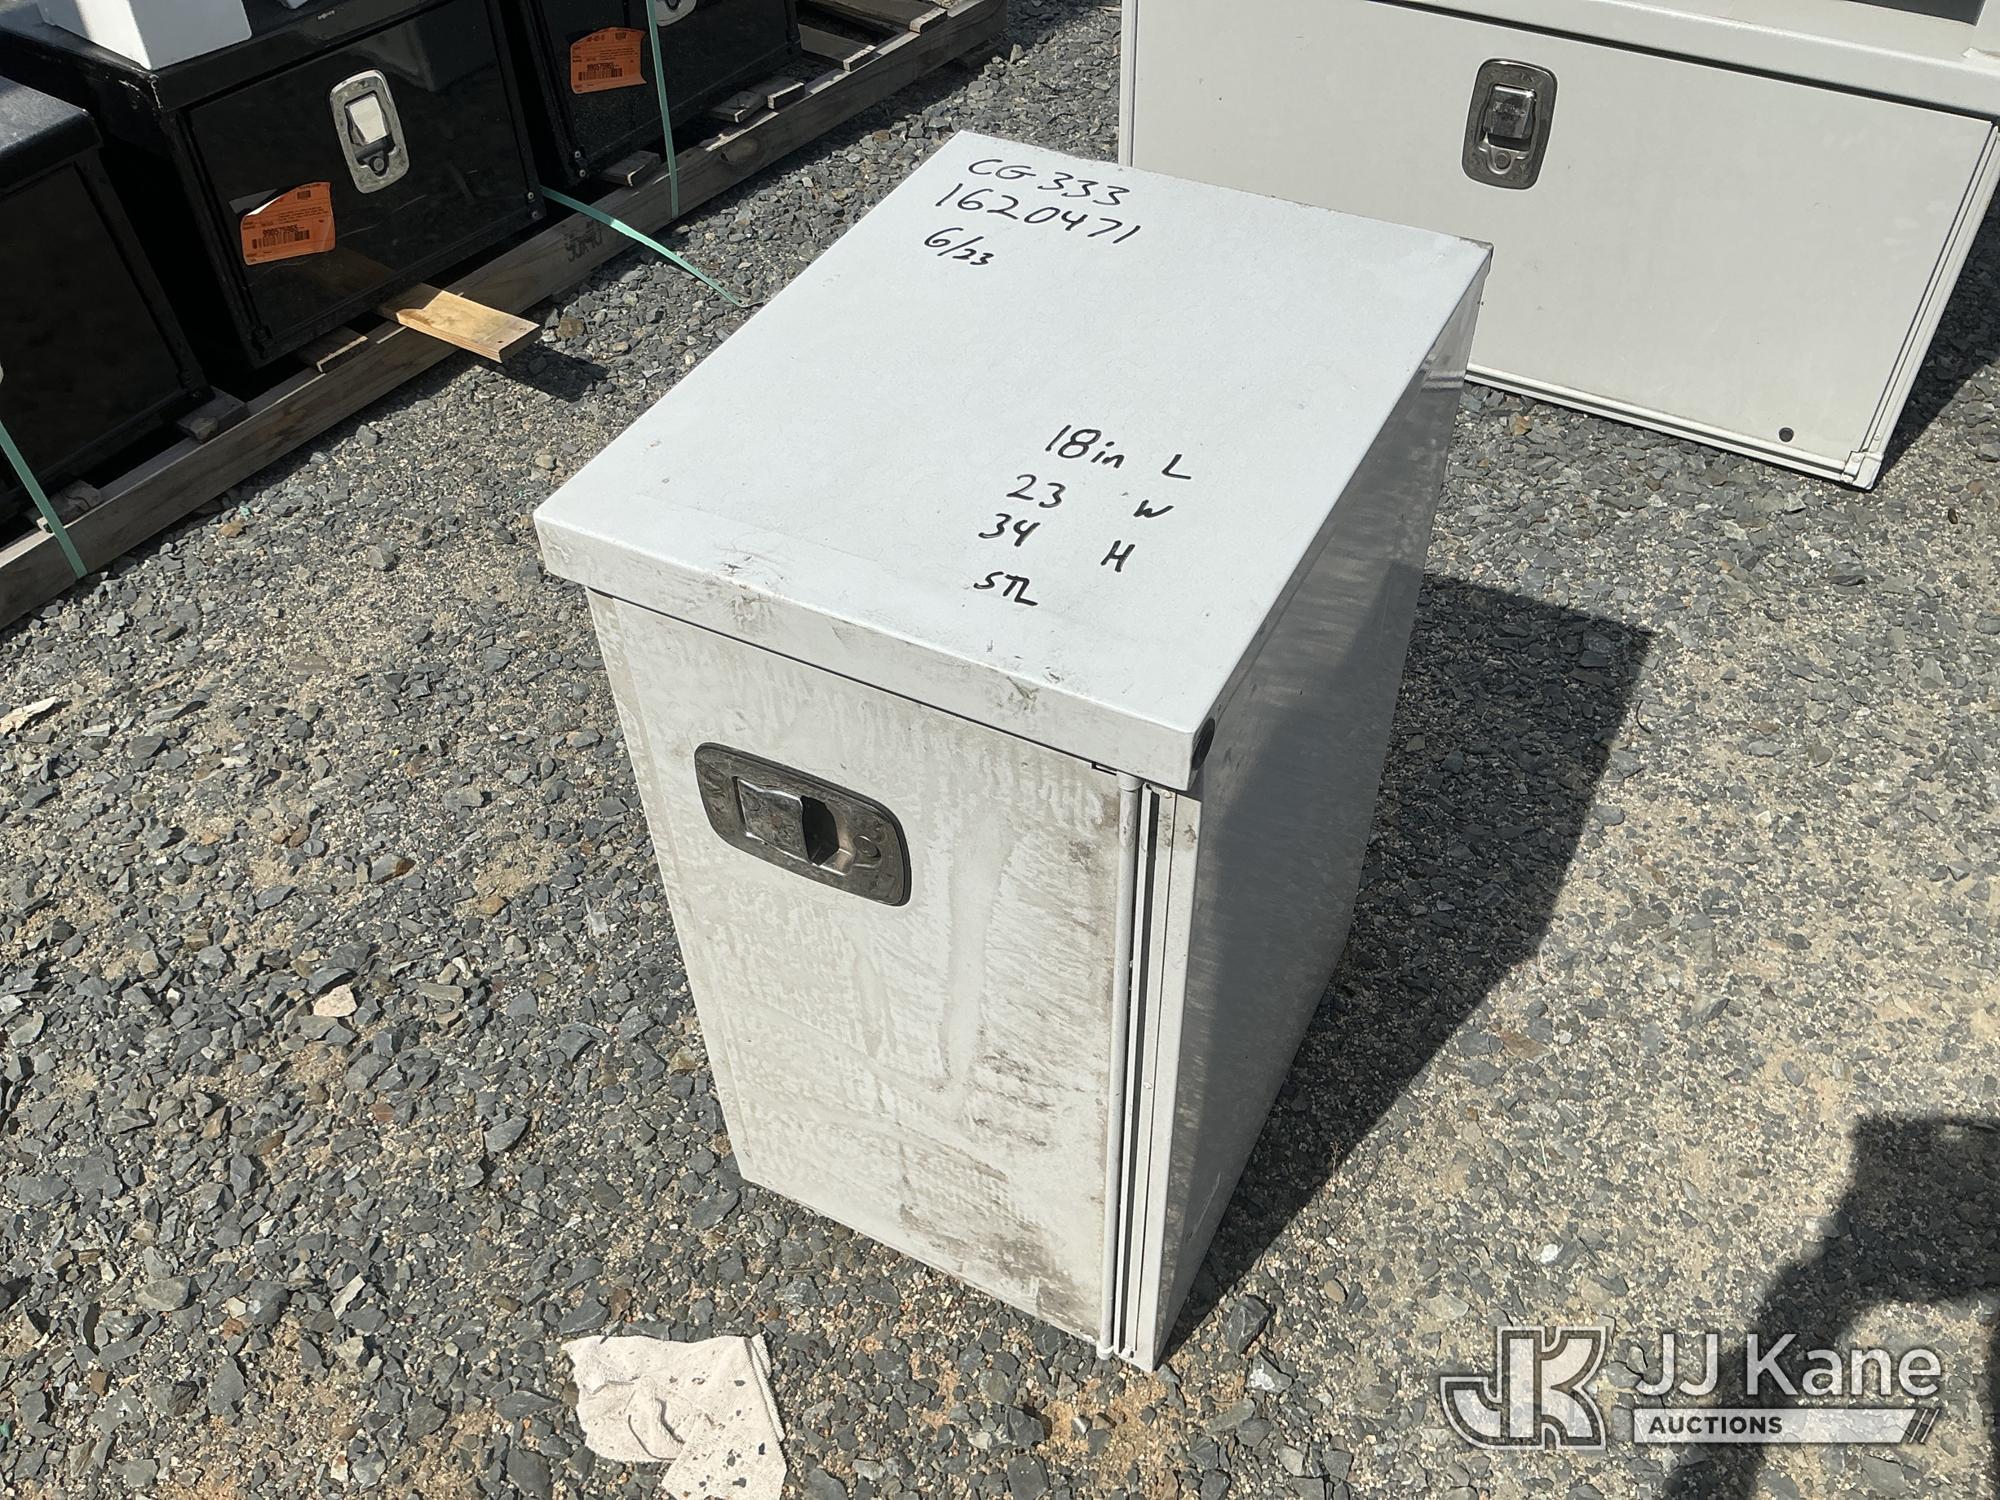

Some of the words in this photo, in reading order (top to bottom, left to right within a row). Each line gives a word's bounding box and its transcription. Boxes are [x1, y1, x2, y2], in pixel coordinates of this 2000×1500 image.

[934, 182, 1142, 244] 1620471
[923, 227, 995, 266] 6/23
[1161, 453, 1192, 480] L
[1005, 474, 1067, 509] 23
[977, 513, 1041, 547] 34
[1099, 540, 1136, 573] H
[972, 571, 1039, 607] STL
